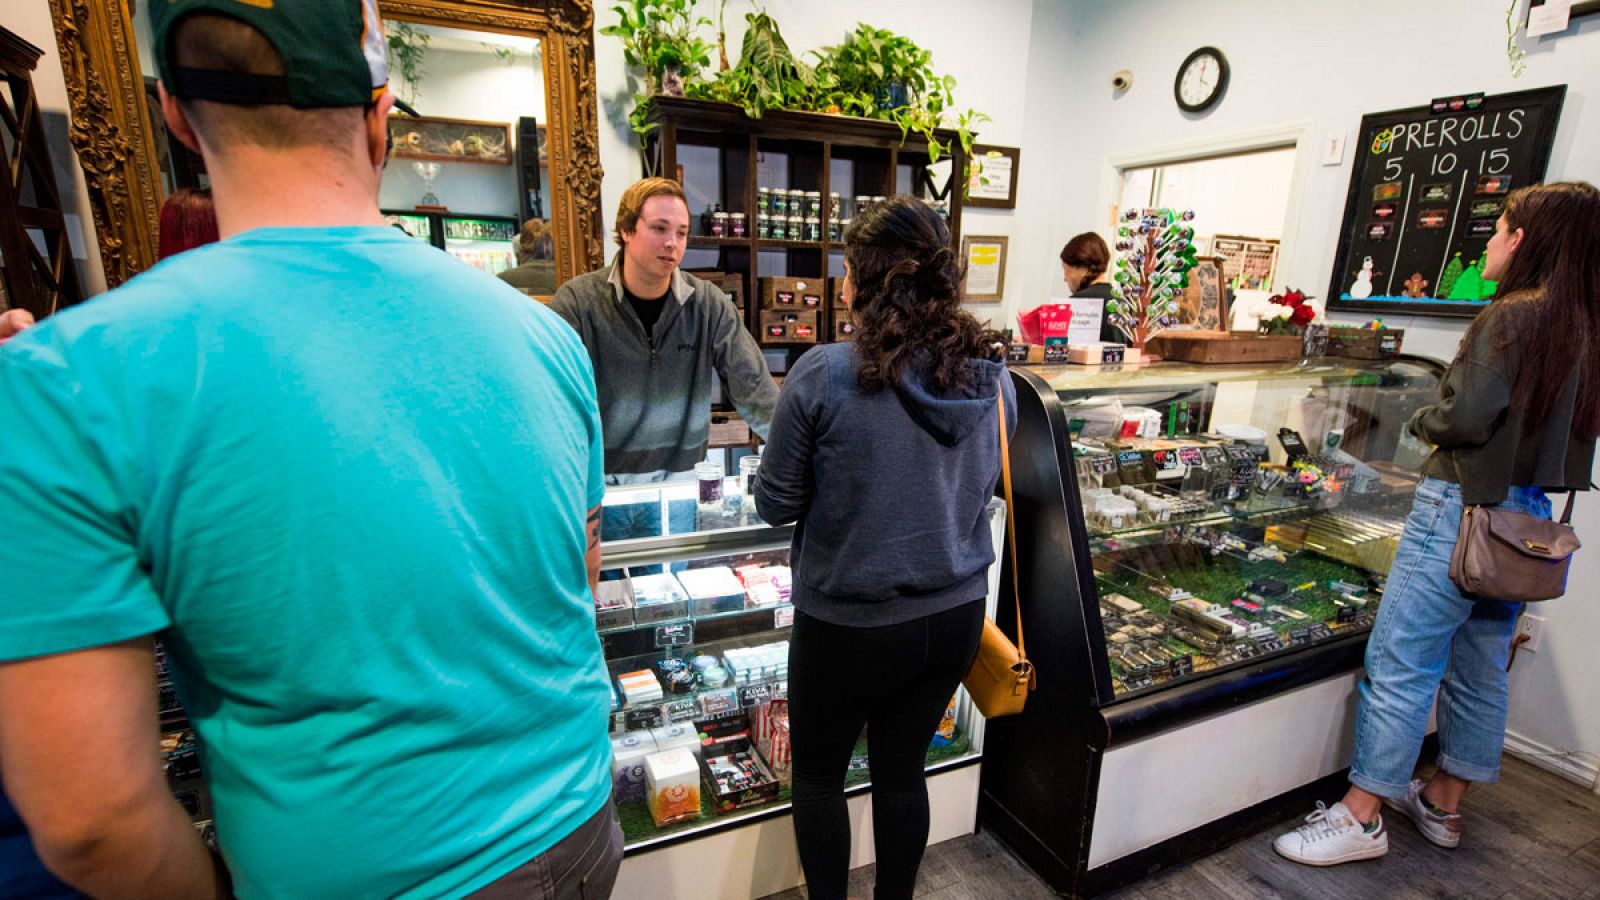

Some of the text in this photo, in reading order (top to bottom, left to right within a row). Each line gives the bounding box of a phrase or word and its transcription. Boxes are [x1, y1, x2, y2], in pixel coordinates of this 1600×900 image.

[1388, 108, 1525, 153] PREROLLS
[1383, 147, 1510, 181] 5 10 15
